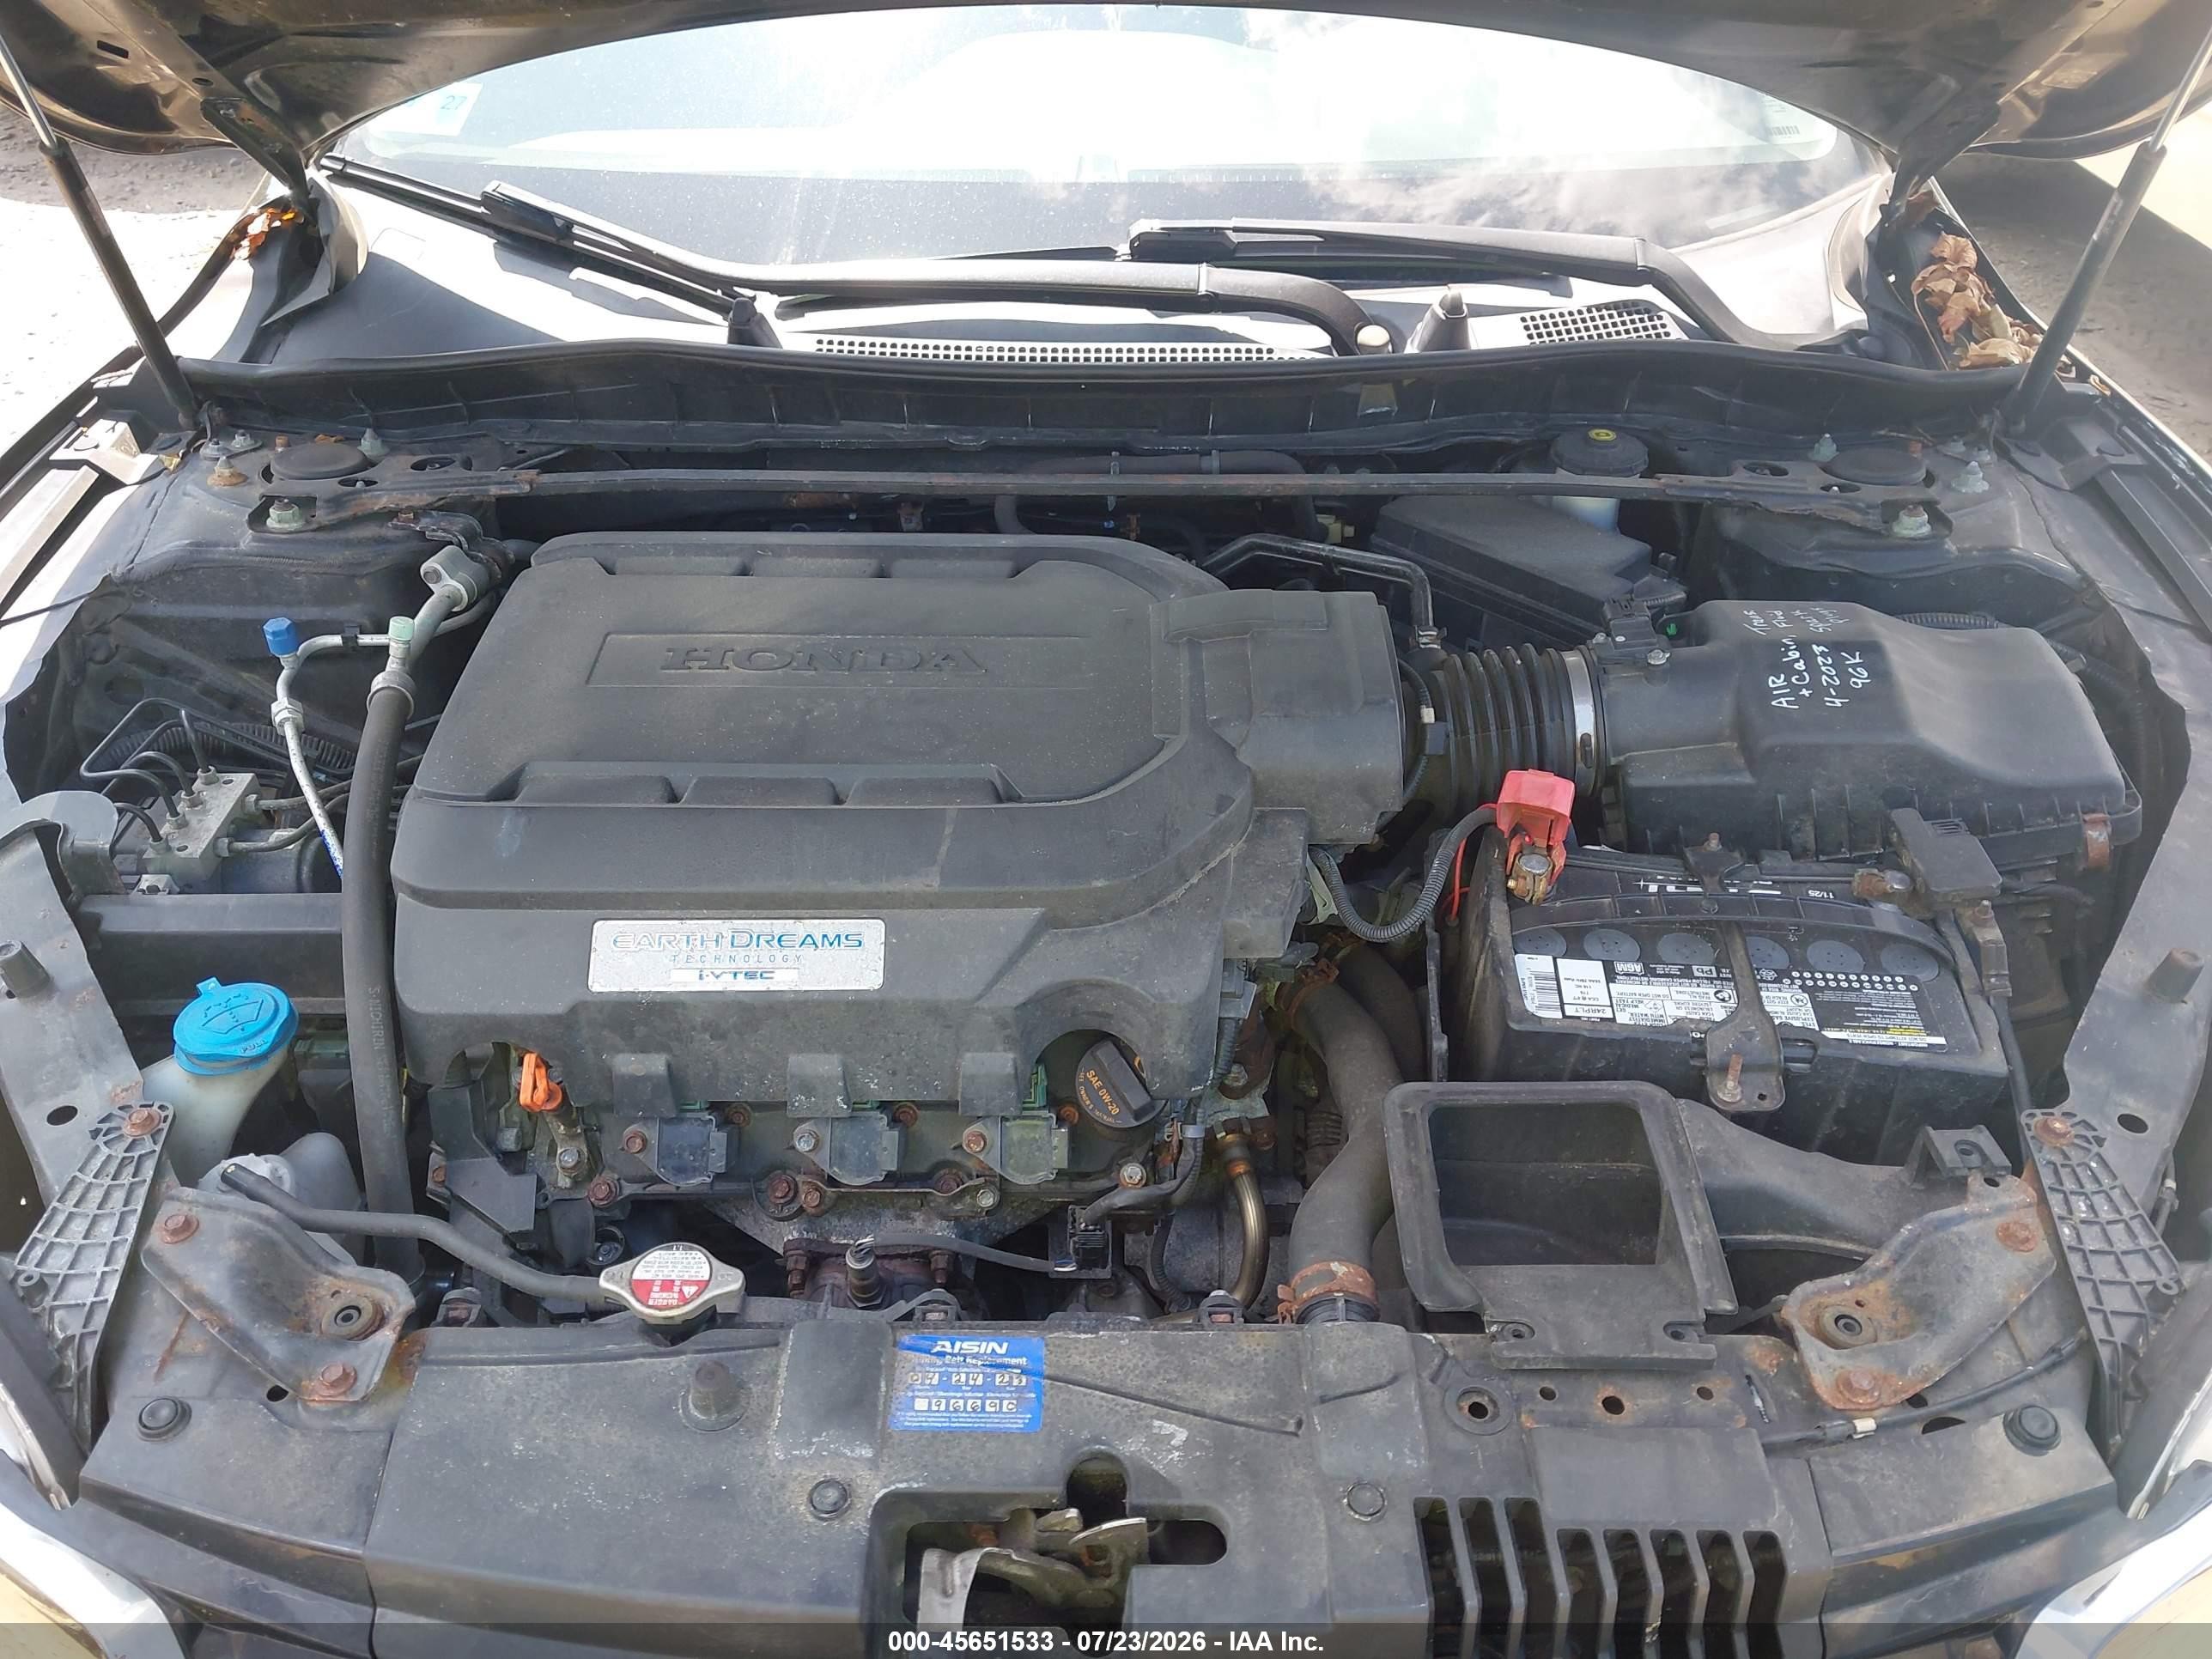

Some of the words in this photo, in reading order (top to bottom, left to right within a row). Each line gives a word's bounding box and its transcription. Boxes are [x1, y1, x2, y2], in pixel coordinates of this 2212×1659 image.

[660, 647, 989, 673] HONDA
[1841, 651, 1871, 689] 96K
[1812, 644, 1850, 707] 4-2023
[1768, 673, 1800, 708] AIR
[1808, 890, 1834, 899] 11/25
[613, 931, 723, 951] EARTH
[730, 927, 863, 950] DREAMS
[670, 954, 803, 964] TECHNOLOGY
[1616, 963, 1641, 972] AGM
[1087, 1070, 1103, 1090] SAE
[1099, 1088, 1119, 1115] 0W-20
[932, 1340, 1009, 1355] AISIN
